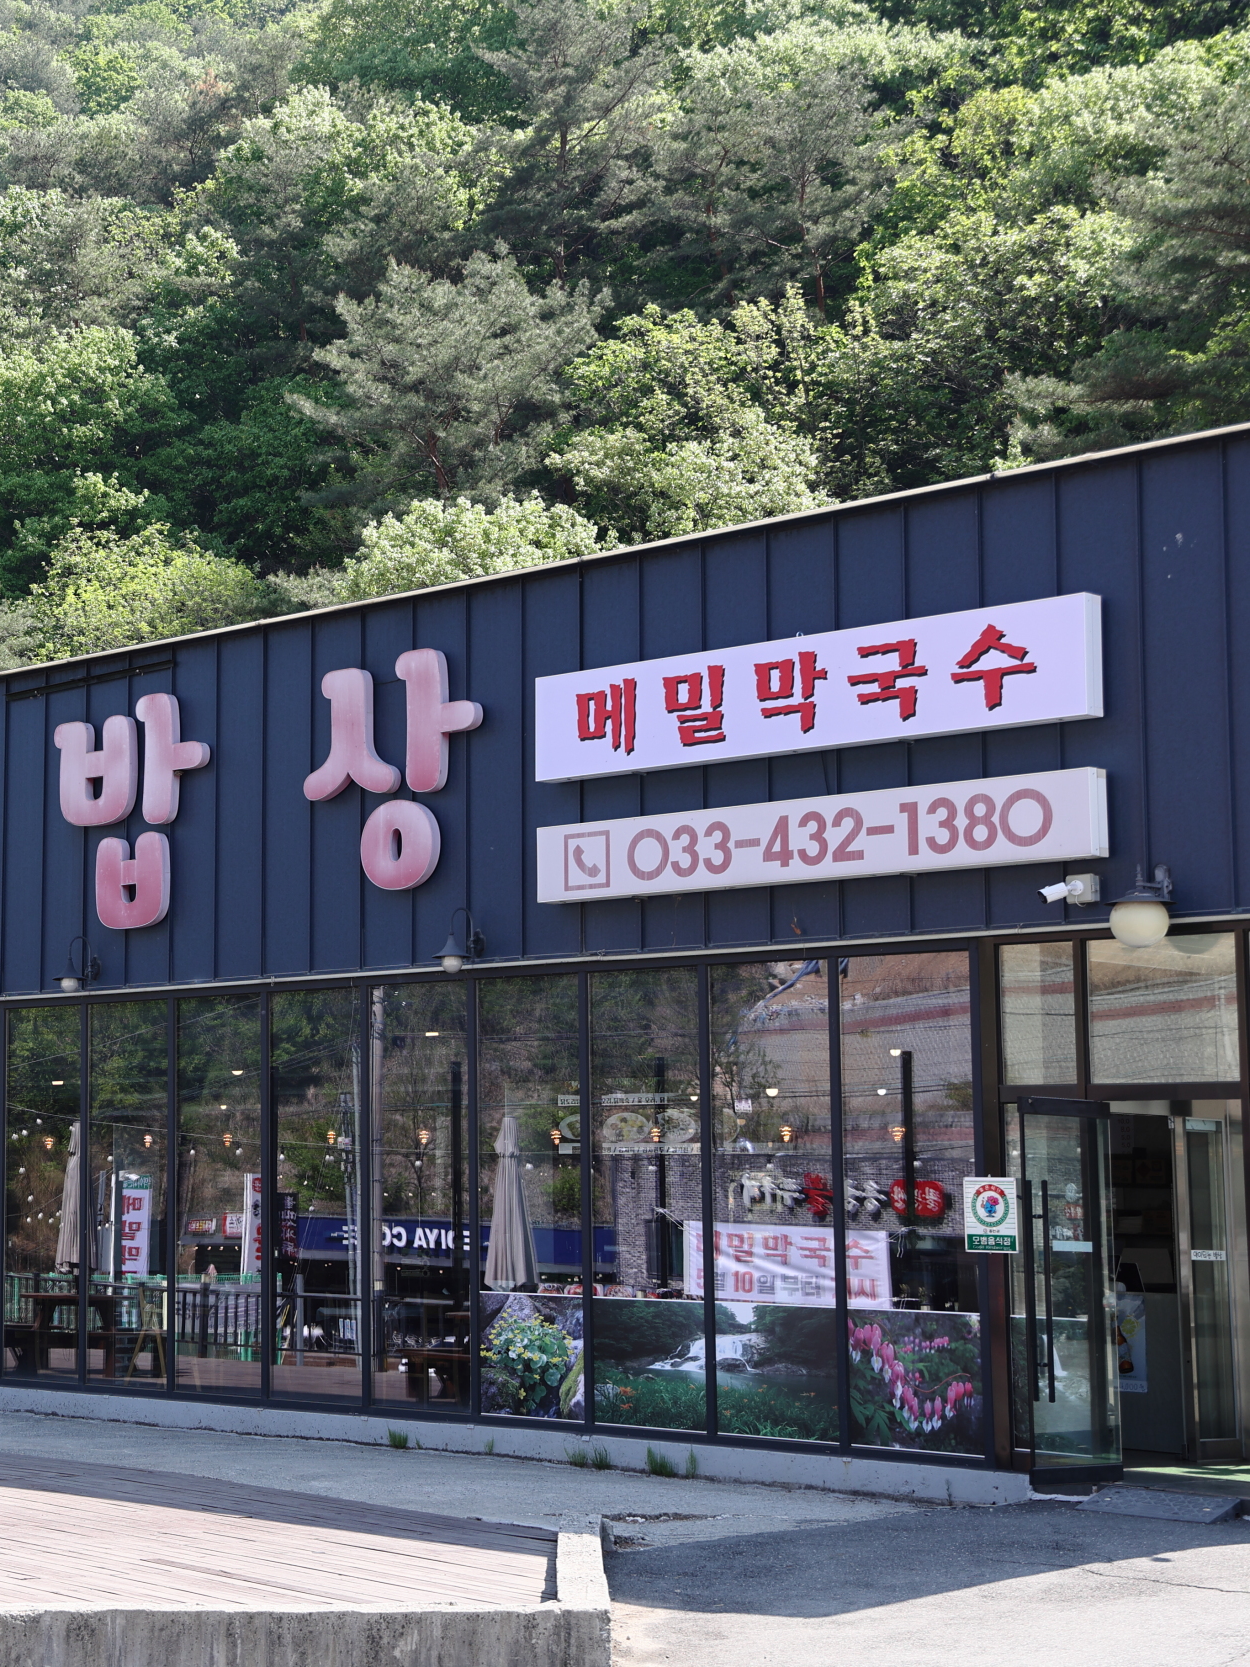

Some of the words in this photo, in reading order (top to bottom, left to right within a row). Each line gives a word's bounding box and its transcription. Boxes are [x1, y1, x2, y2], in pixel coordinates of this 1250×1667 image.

[575, 623, 1037, 756] 메밀막국수
[53, 648, 484, 930] 밥상
[626, 788, 1053, 881] 033-432-1380
[972, 1236, 1011, 1246] 모범음식점
